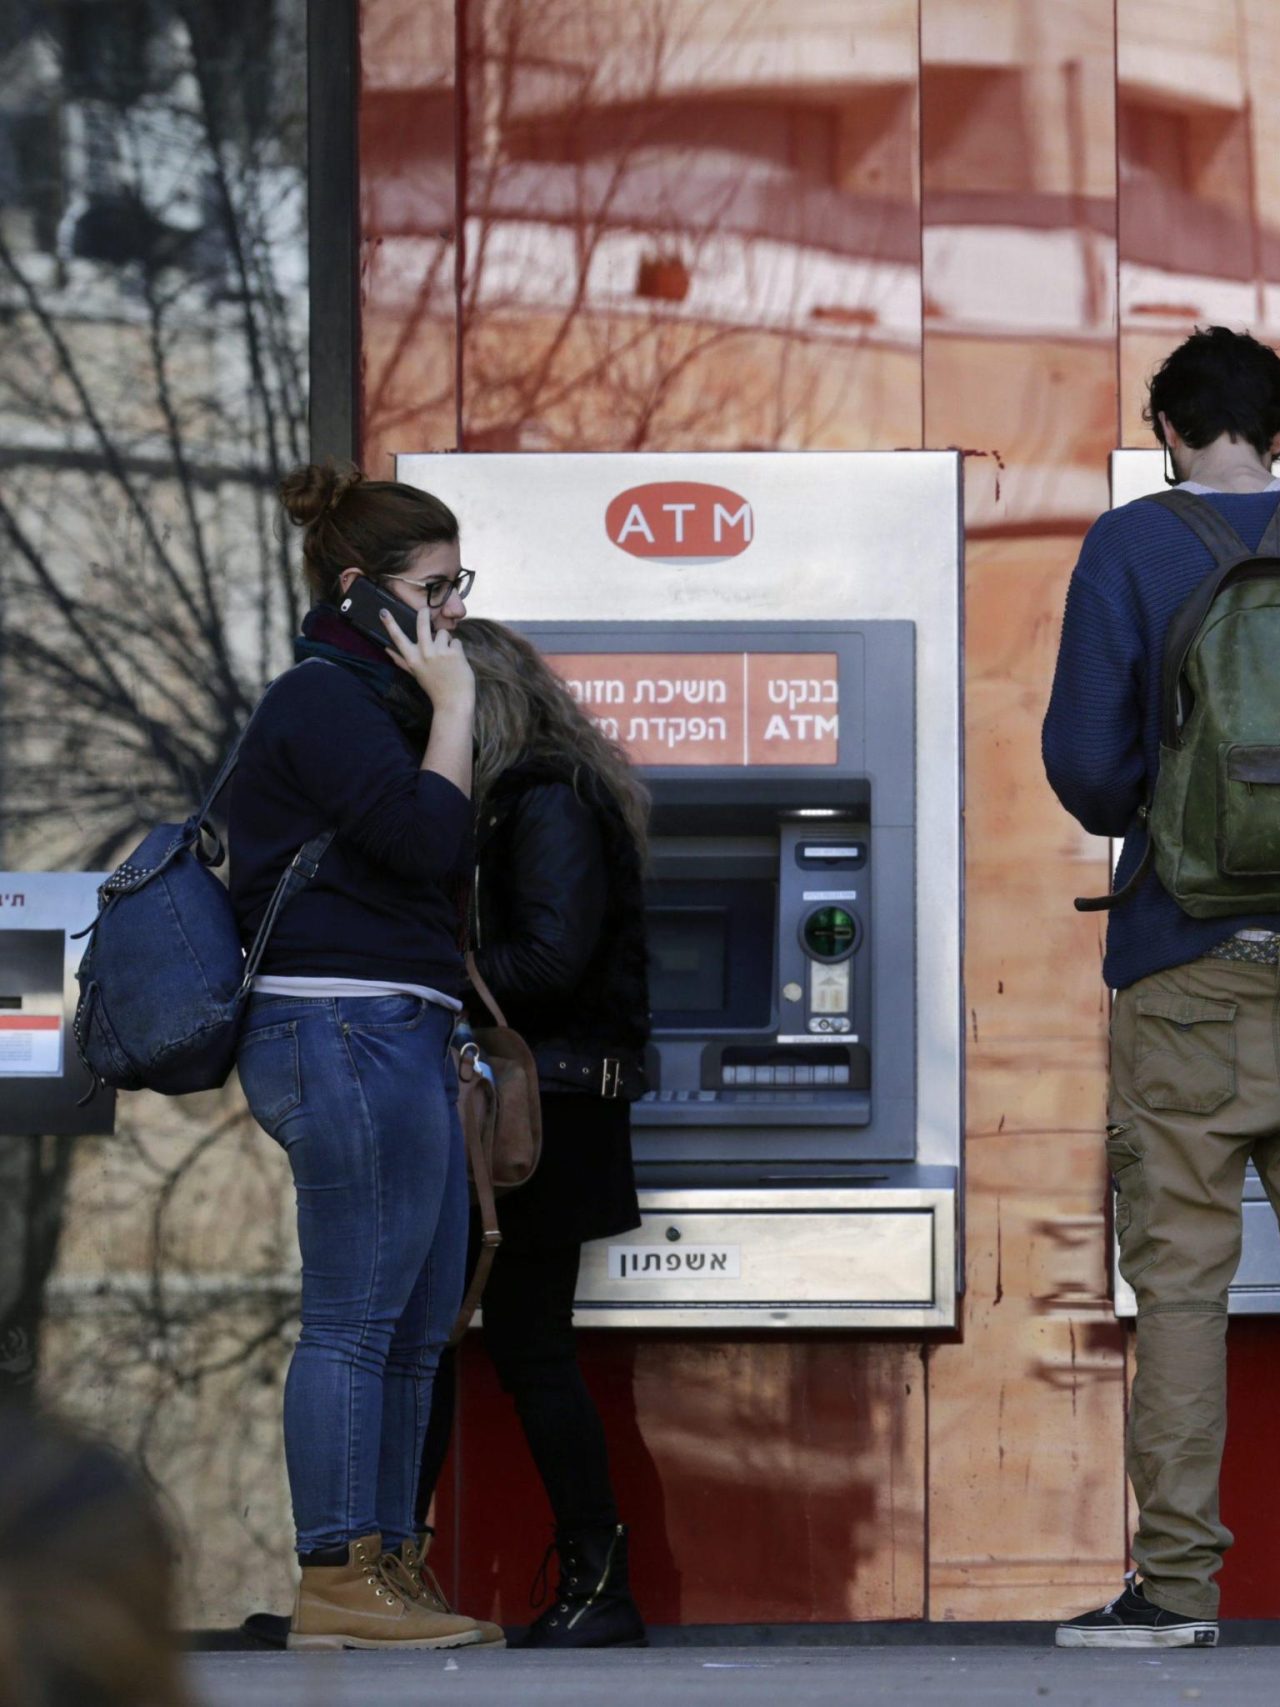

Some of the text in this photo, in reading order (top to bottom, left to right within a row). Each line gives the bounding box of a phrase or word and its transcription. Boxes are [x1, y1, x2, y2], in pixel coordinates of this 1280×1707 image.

[616, 503, 750, 543] ATM
[565, 679, 727, 704] משיכת מזומ
[768, 679, 839, 710] בנקט
[626, 717, 727, 748] הפקדת
[763, 715, 839, 741] ATM
[620, 1252, 728, 1278] אשפתון
